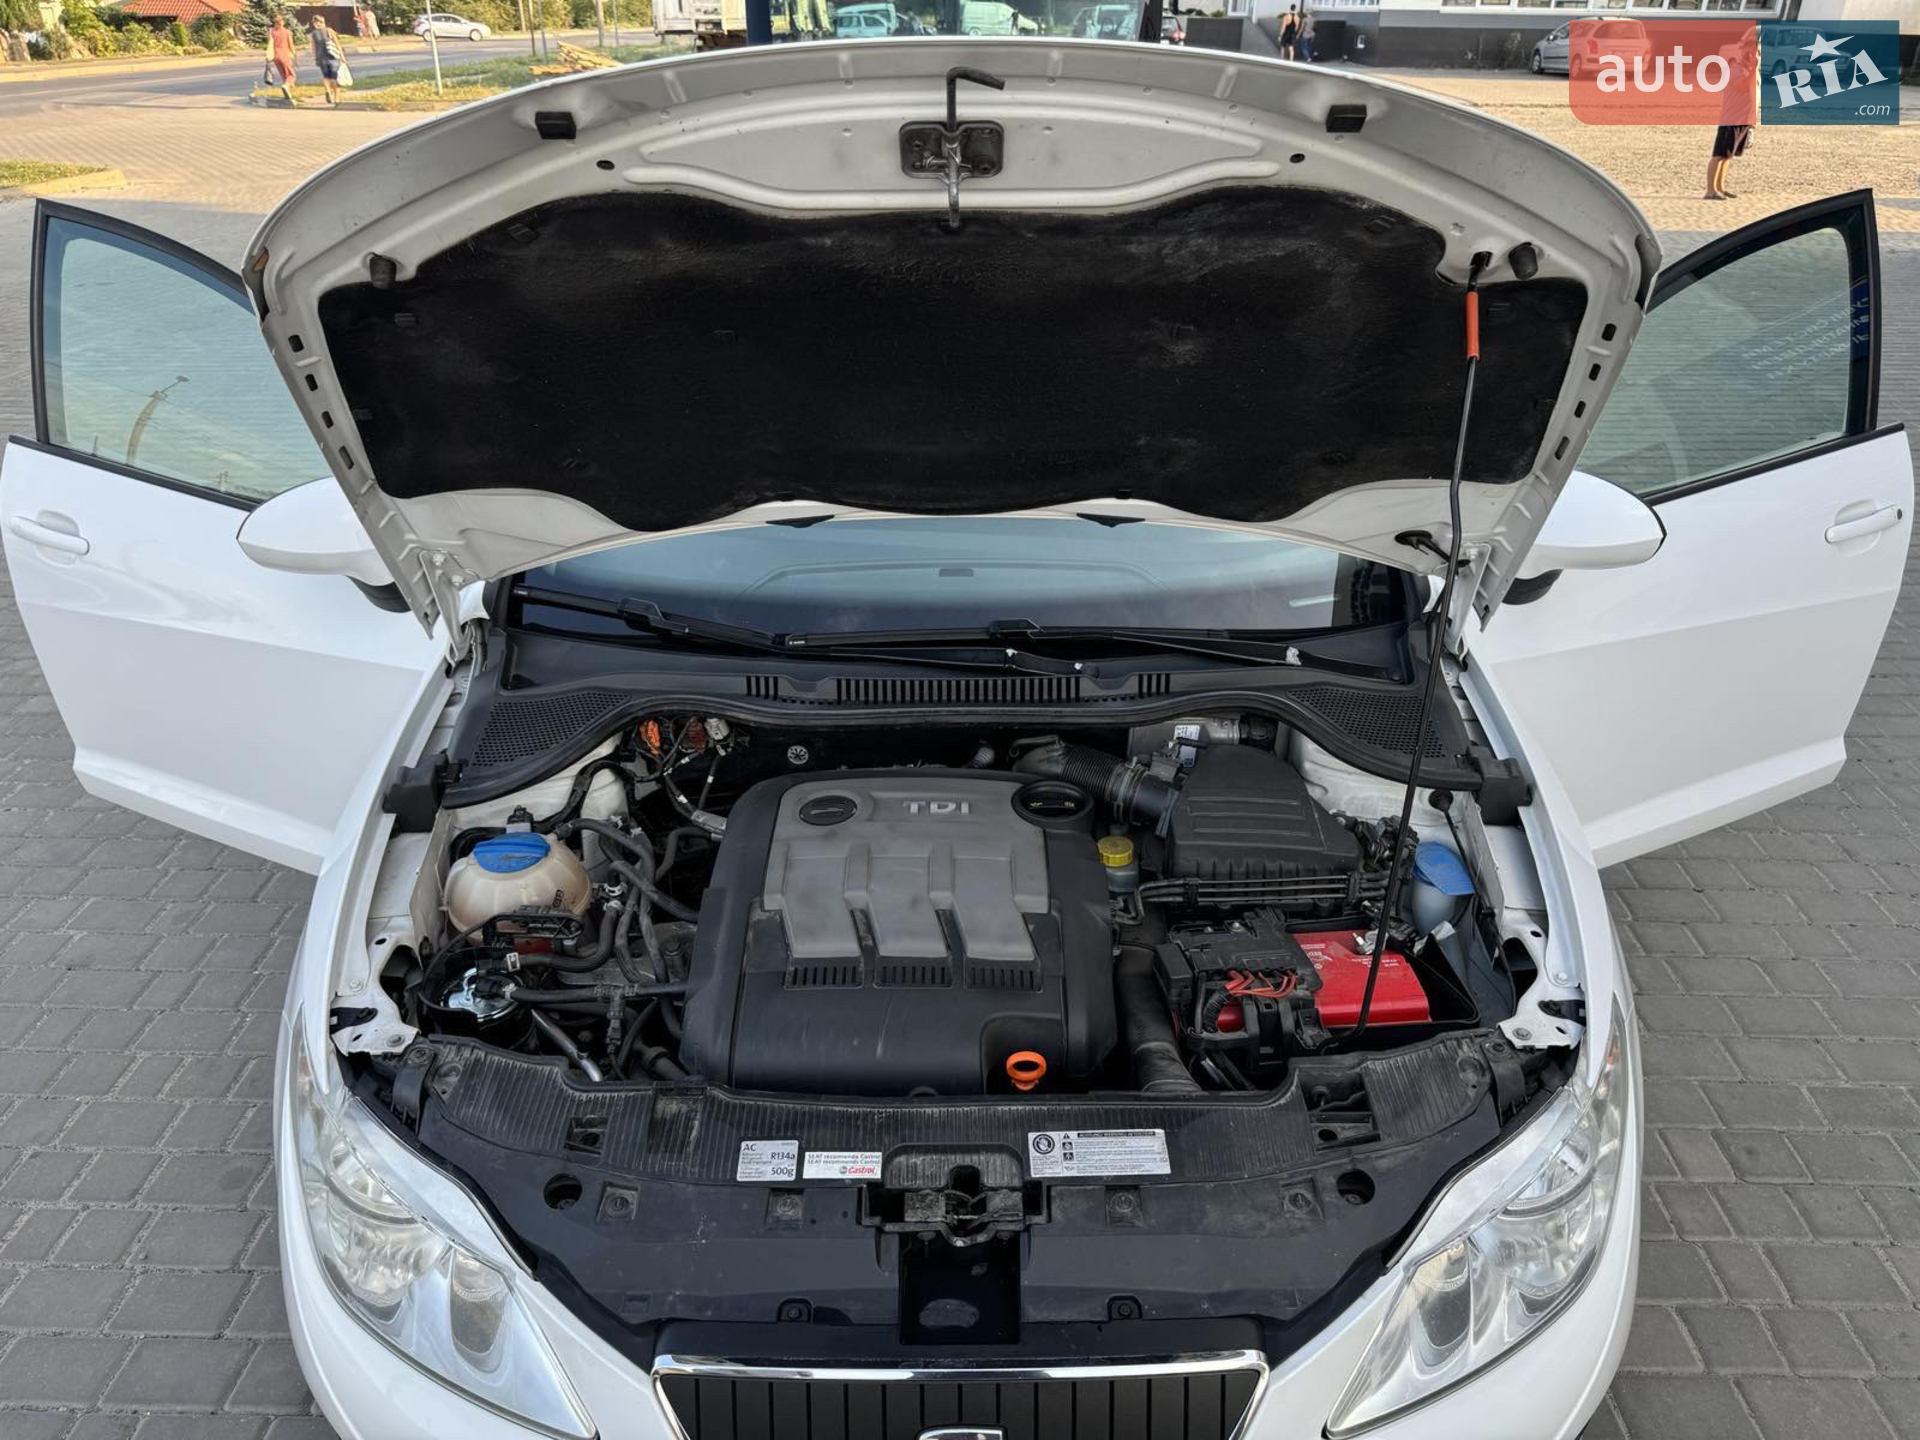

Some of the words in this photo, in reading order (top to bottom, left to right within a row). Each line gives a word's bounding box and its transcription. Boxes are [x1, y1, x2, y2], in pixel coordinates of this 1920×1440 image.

[902, 801, 970, 814] TDI
[742, 1143, 757, 1152] AC
[770, 1151, 796, 1160] R134a
[770, 1166, 794, 1178] 500g
[847, 1165, 876, 1175] Castrol
